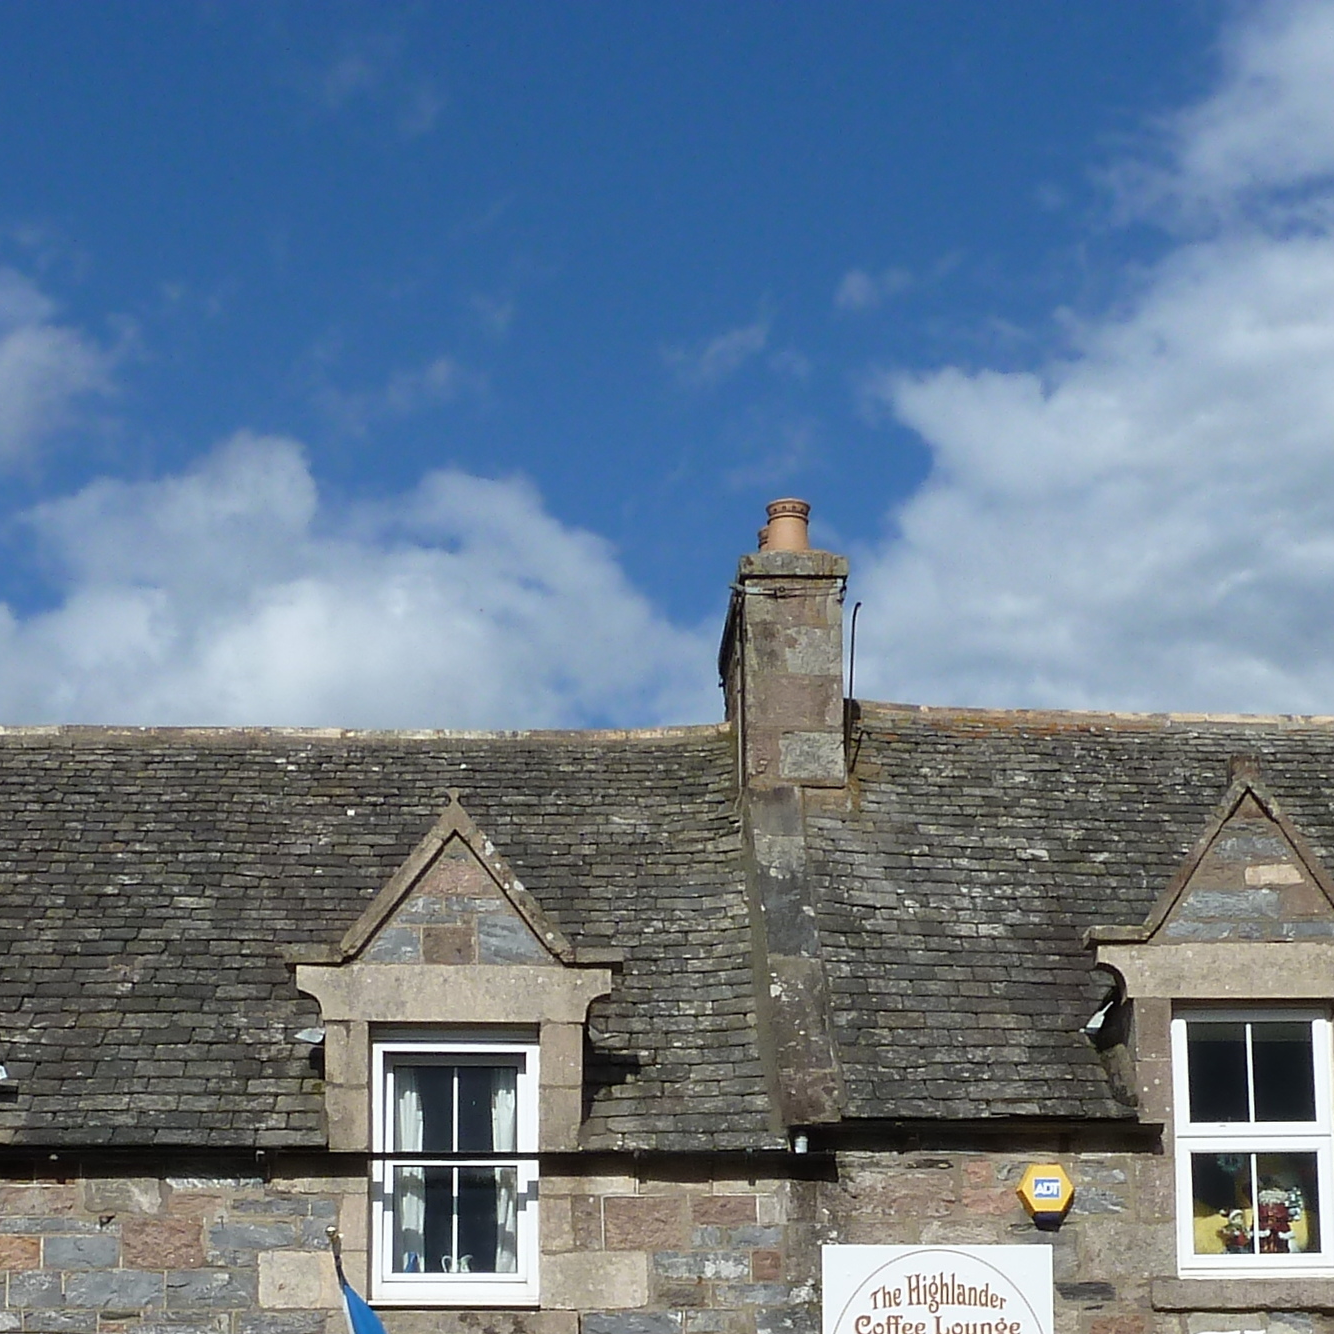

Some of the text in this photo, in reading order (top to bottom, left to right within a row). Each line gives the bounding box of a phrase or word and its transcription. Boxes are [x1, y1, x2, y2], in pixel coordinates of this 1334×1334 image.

[1034, 1182, 1060, 1195] ADT
[870, 1272, 1007, 1313] The Highlander
